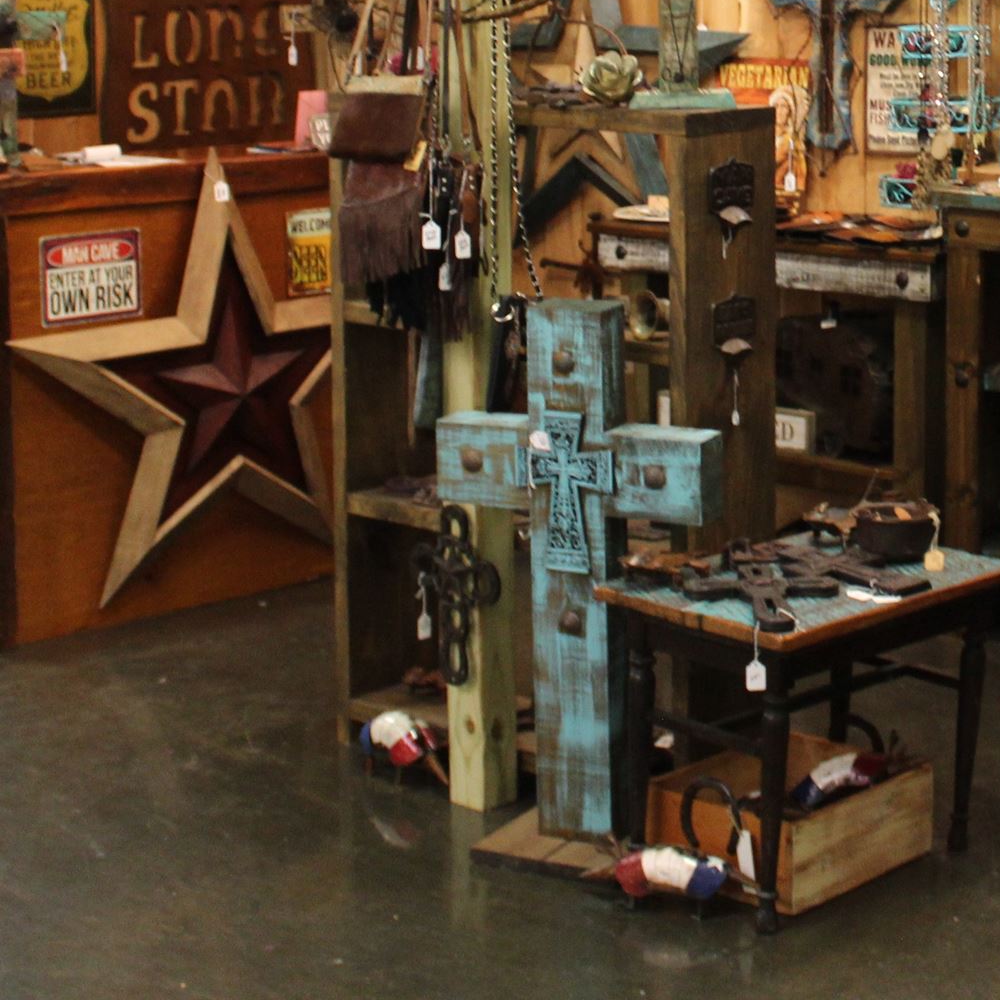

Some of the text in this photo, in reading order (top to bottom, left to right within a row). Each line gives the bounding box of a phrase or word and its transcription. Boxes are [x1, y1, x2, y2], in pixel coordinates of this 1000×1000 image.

[26, 71, 72, 90] BEER
[720, 62, 810, 90] VEGETARIAN
[49, 264, 133, 289] ENTER AT YOUR
[50, 283, 134, 316] OWN RISK
